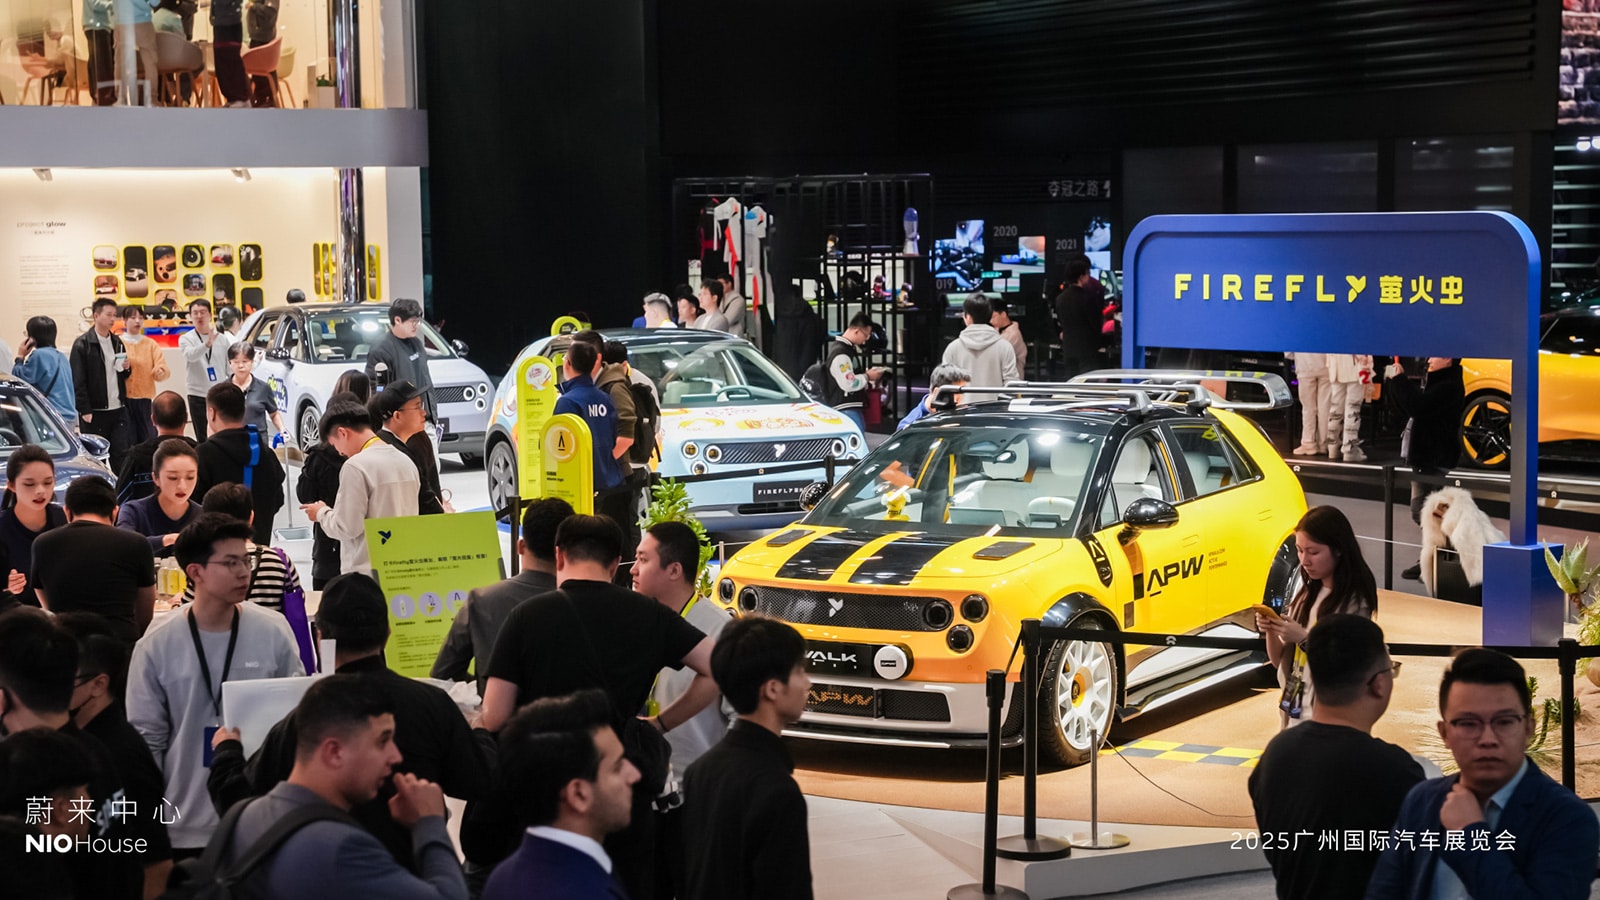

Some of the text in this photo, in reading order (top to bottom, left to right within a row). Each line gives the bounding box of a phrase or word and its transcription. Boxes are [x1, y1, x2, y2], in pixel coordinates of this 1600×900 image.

[1048, 181, 1099, 198] 夺冠之路
[46, 220, 66, 228] glow
[993, 226, 1018, 237] 2020
[1055, 239, 1077, 250] 2021
[935, 278, 954, 290] 019
[1174, 273, 1463, 305] FIREFLY 萤火虫
[588, 403, 608, 418] NIO
[757, 487, 794, 496] FIREFLY
[1146, 554, 1204, 597] APW
